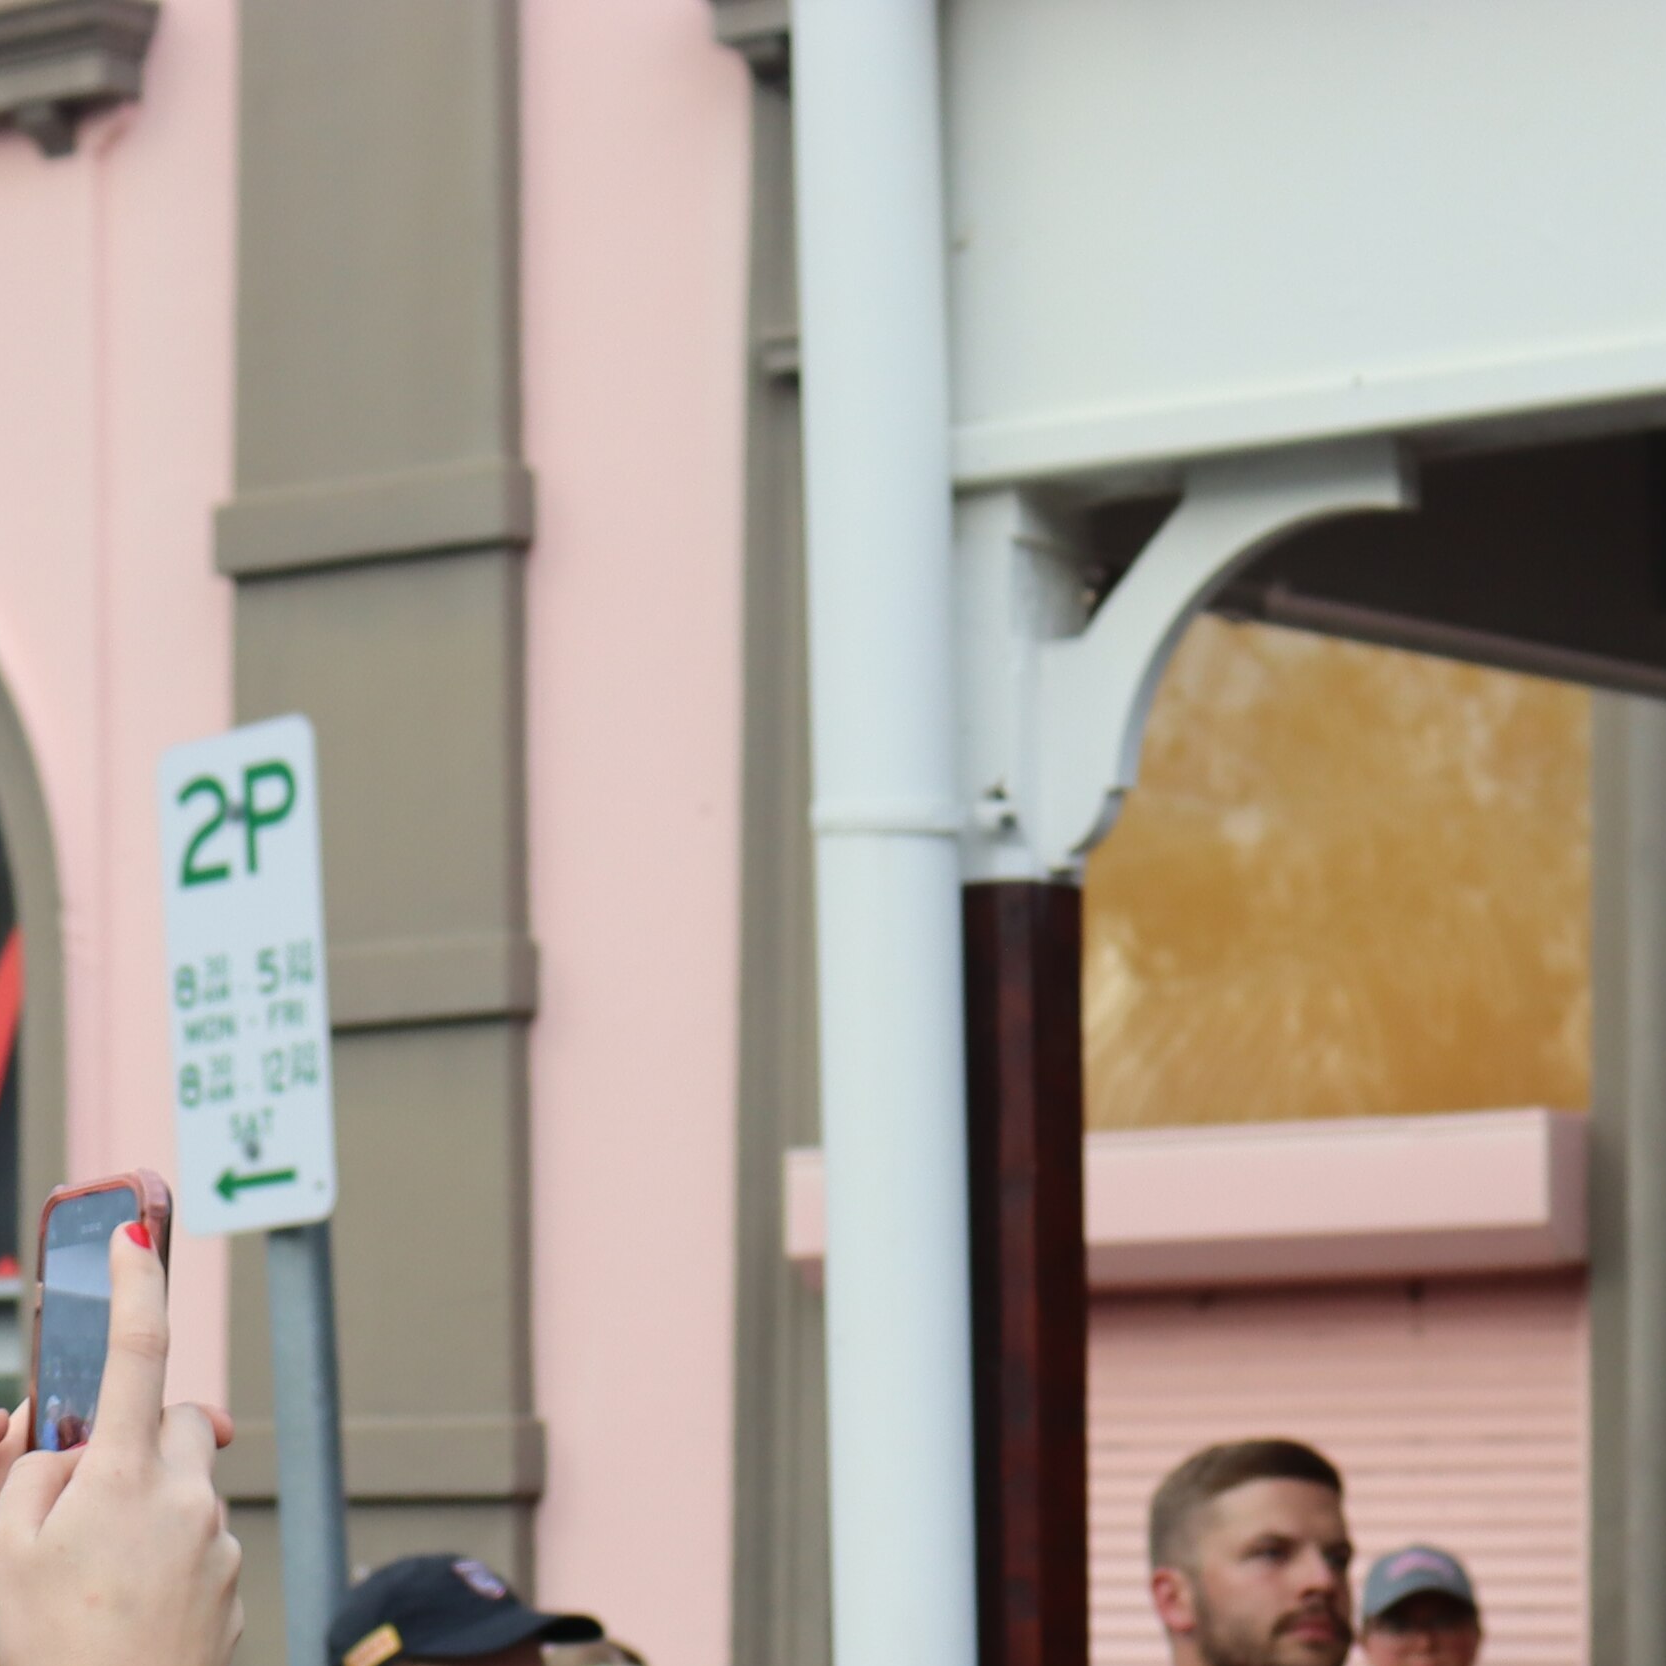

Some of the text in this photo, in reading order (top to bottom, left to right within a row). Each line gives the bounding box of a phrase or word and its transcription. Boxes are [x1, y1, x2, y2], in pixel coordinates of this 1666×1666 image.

[176, 758, 297, 888] 2P
[175, 964, 197, 1010] 8
[256, 945, 280, 995] 5
[183, 1012, 236, 1046] MON
[267, 998, 304, 1031] FRI
[180, 1061, 201, 1109] 8
